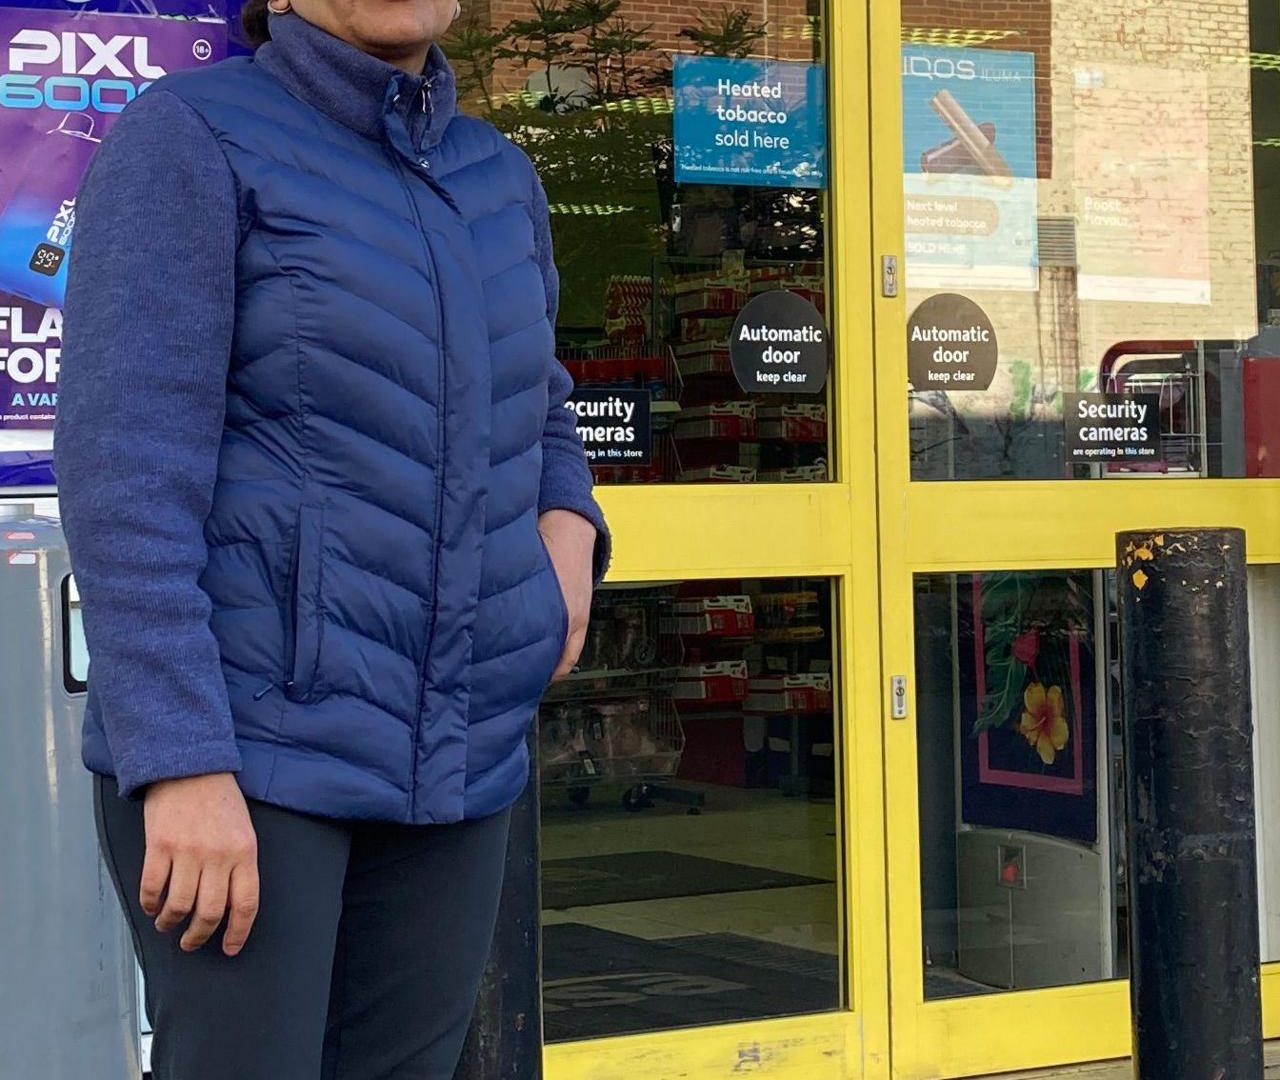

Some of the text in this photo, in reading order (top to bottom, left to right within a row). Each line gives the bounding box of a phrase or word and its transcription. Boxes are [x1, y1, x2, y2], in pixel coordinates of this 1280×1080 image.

[7, 28, 168, 80] PIXL
[901, 56, 975, 81] IQOS
[718, 78, 783, 99] Heated
[716, 104, 788, 125] tobacco
[715, 130, 790, 150] sold here
[907, 200, 958, 213] Next level
[907, 215, 944, 229] heated
[906, 241, 936, 254] SOLD
[738, 325, 823, 343] Automatic
[911, 325, 990, 343] Automatic
[761, 345, 802, 364] door
[933, 345, 970, 364] door
[756, 370, 807, 385] keep clear
[927, 369, 976, 385] keep clear
[11, 392, 25, 407] A
[3, 414, 29, 422] product
[1078, 399, 1148, 424] Security
[1079, 425, 1148, 443] cameras
[607, 448, 644, 458] this store
[1072, 446, 1155, 458] are operating this store
